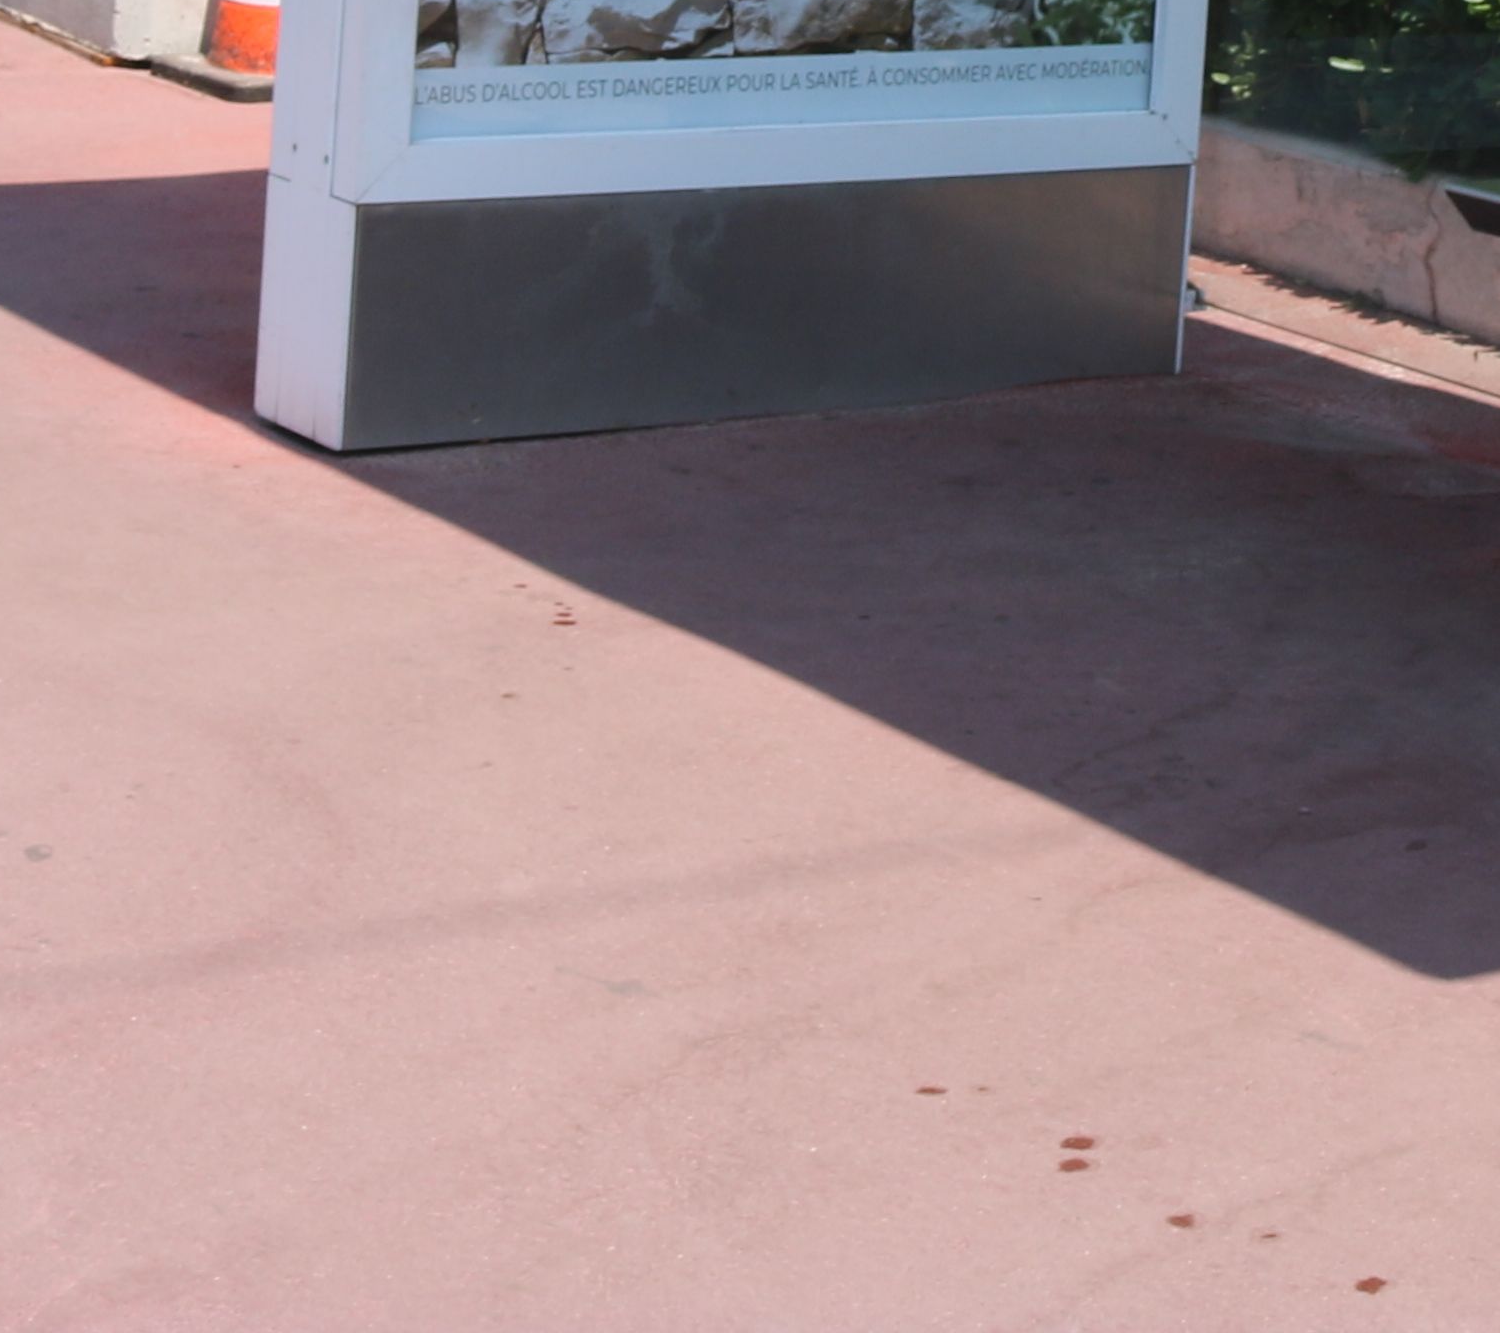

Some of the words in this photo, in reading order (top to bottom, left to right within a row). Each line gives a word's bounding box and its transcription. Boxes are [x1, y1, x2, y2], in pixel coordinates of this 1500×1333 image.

[414, 83, 476, 105] L'ABUS
[482, 81, 571, 103] D'ALCOOL
[576, 80, 608, 99] EST
[612, 75, 722, 98] DANGEREUX
[727, 73, 777, 93] POUR
[781, 72, 802, 91] LA
[867, 65, 878, 86] À
[882, 63, 991, 86] CONSOMMER
[997, 62, 1038, 82] AVEC
